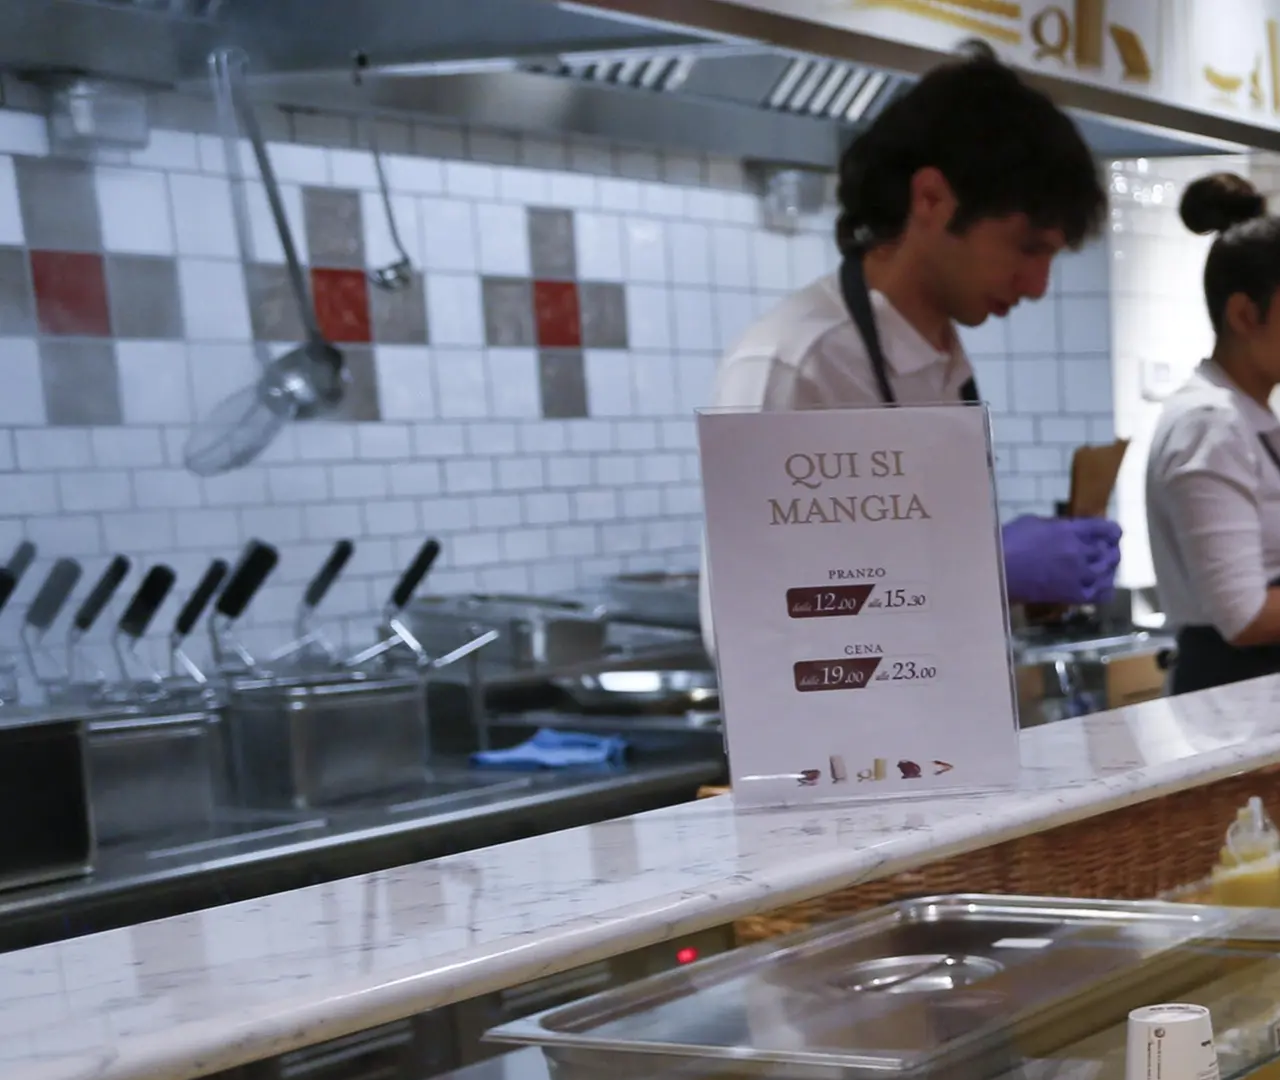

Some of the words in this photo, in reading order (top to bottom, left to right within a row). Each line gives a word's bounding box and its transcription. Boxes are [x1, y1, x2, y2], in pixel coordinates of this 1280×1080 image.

[784, 452, 861, 490] QUI
[870, 450, 905, 478] SI
[768, 493, 932, 526] MANGIA
[828, 567, 887, 580] PRANZO
[814, 592, 857, 612] 12.00
[884, 589, 926, 608] 15.30
[843, 643, 884, 656] CENA
[821, 665, 864, 685] 19.00
[892, 661, 937, 680] 23.00
